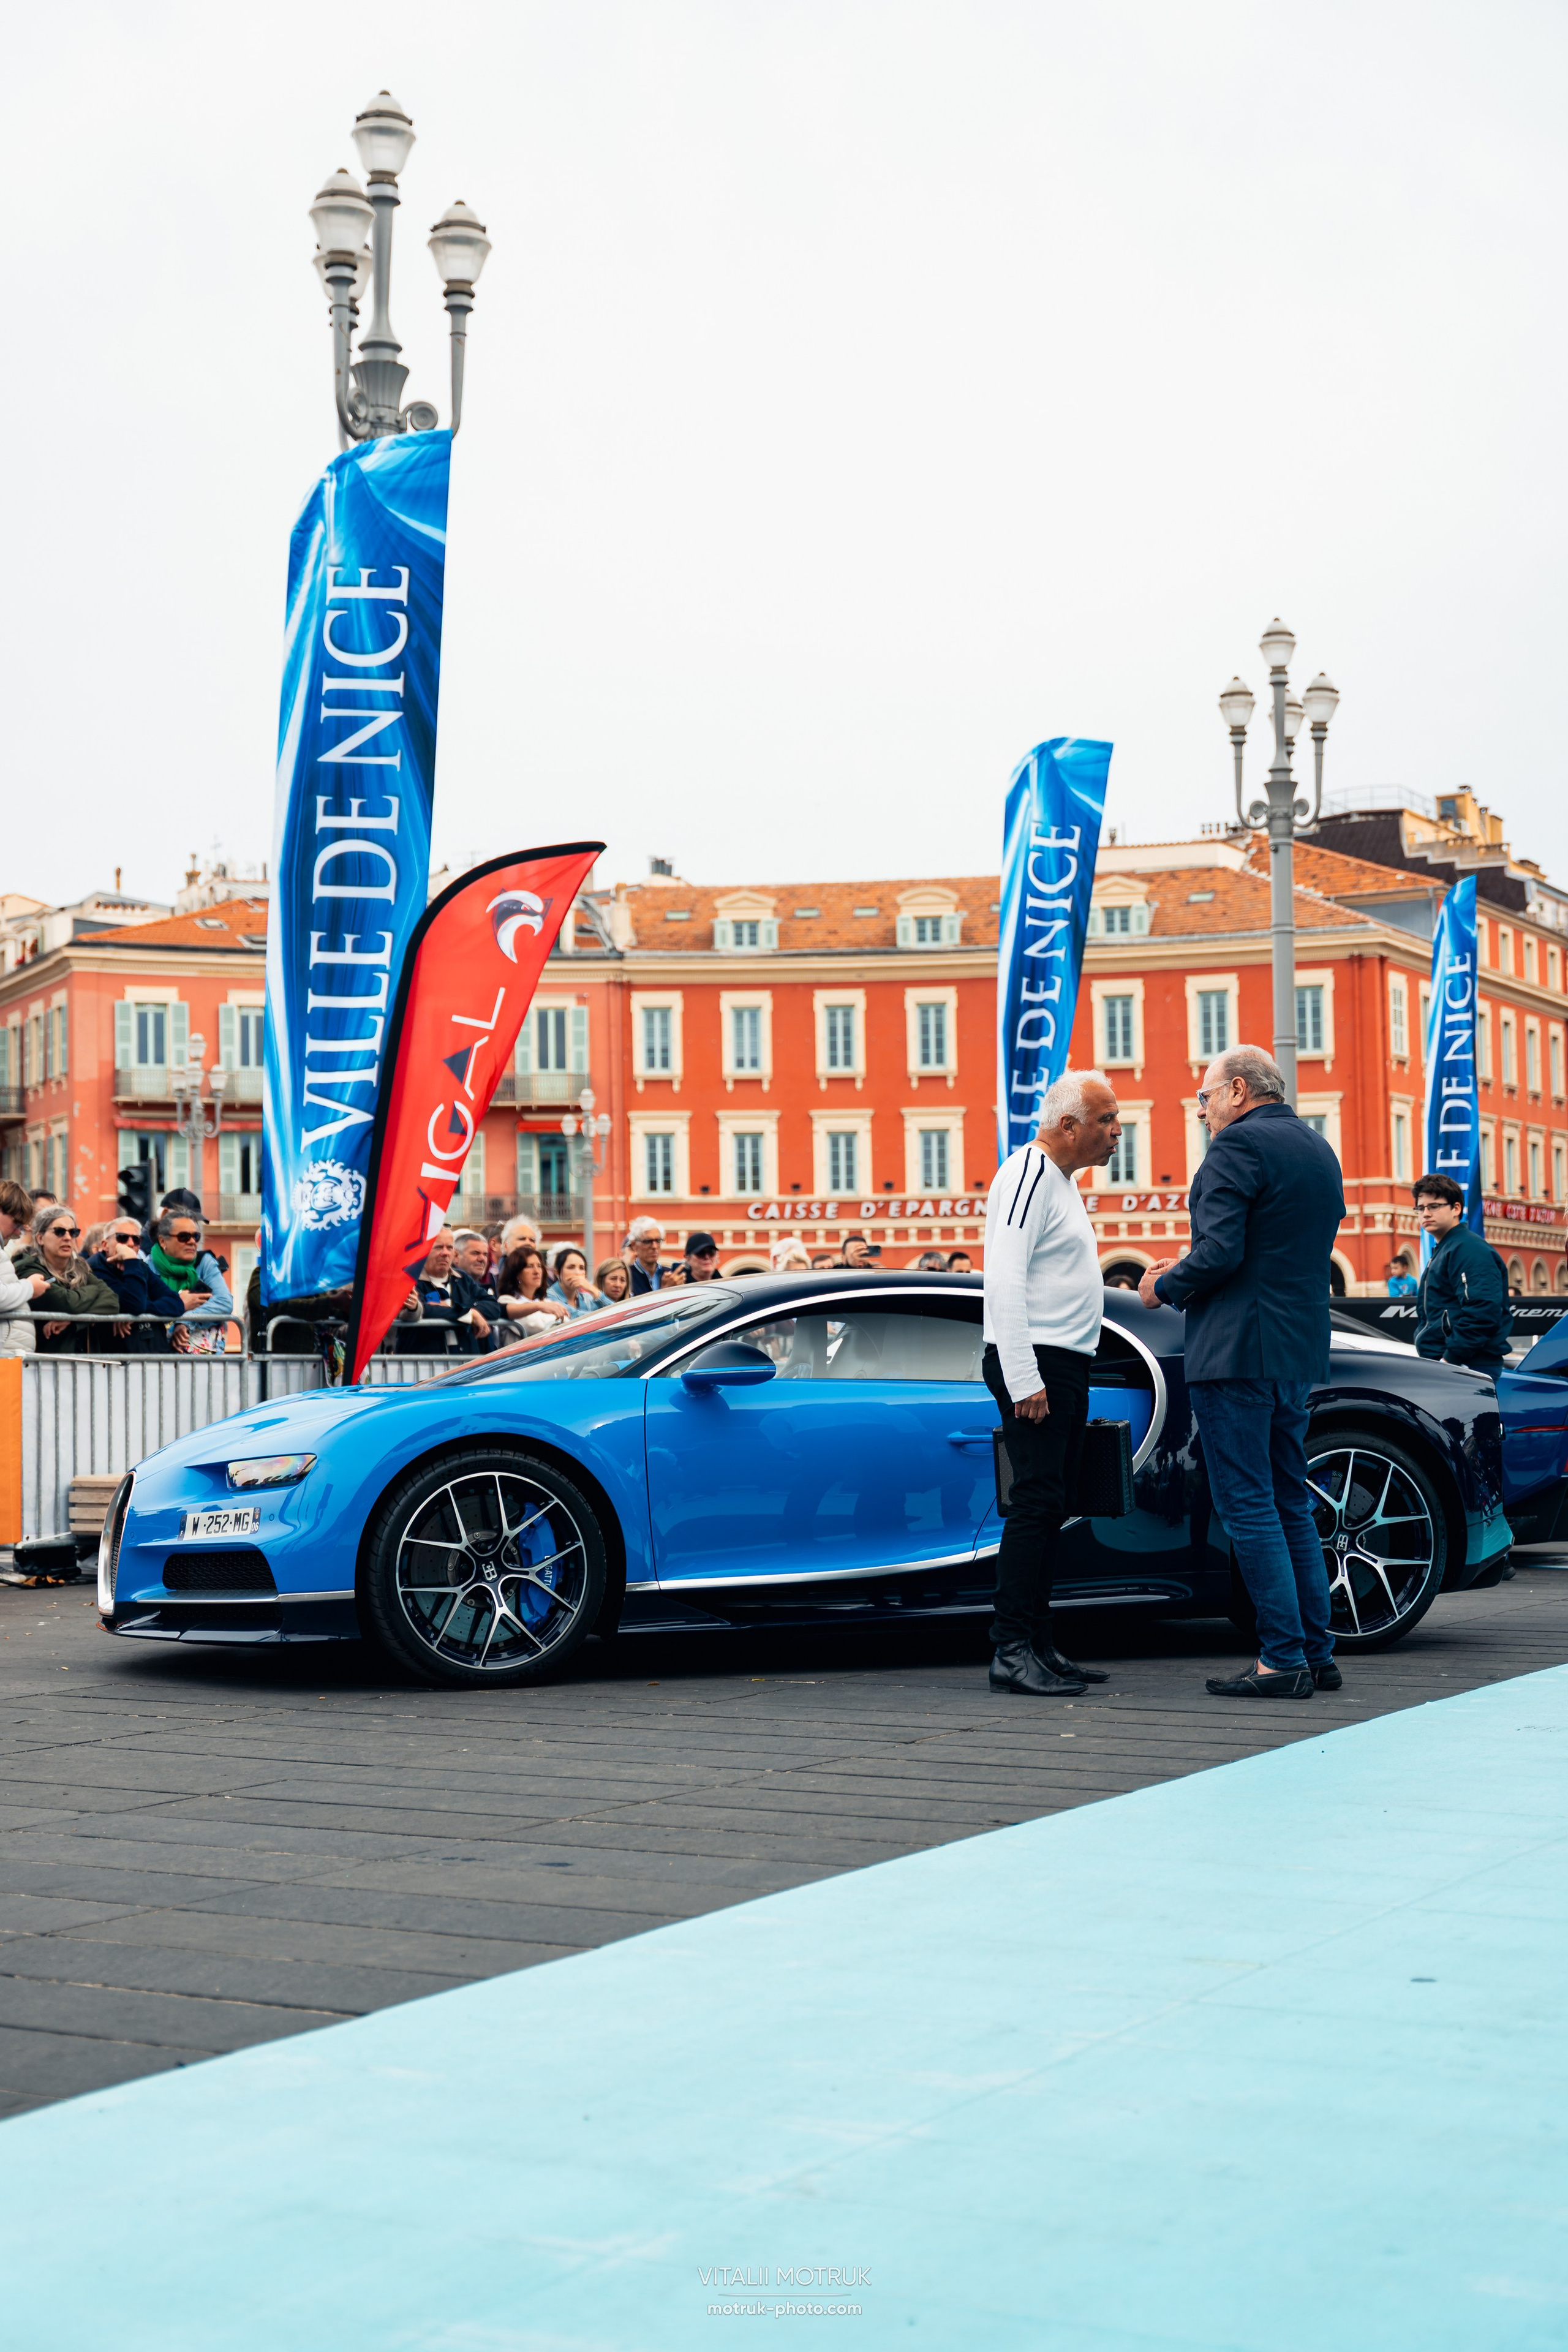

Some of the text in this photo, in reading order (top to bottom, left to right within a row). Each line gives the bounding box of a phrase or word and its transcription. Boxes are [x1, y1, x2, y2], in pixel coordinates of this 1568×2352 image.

[300, 564, 410, 1153] VILLE DE NICE
[1022, 820, 1082, 962] NICE
[1014, 974, 1062, 1052] DE
[1442, 951, 1475, 1062] NICE
[1438, 1074, 1474, 1135] DE
[747, 1202, 839, 1220] CAISSE
